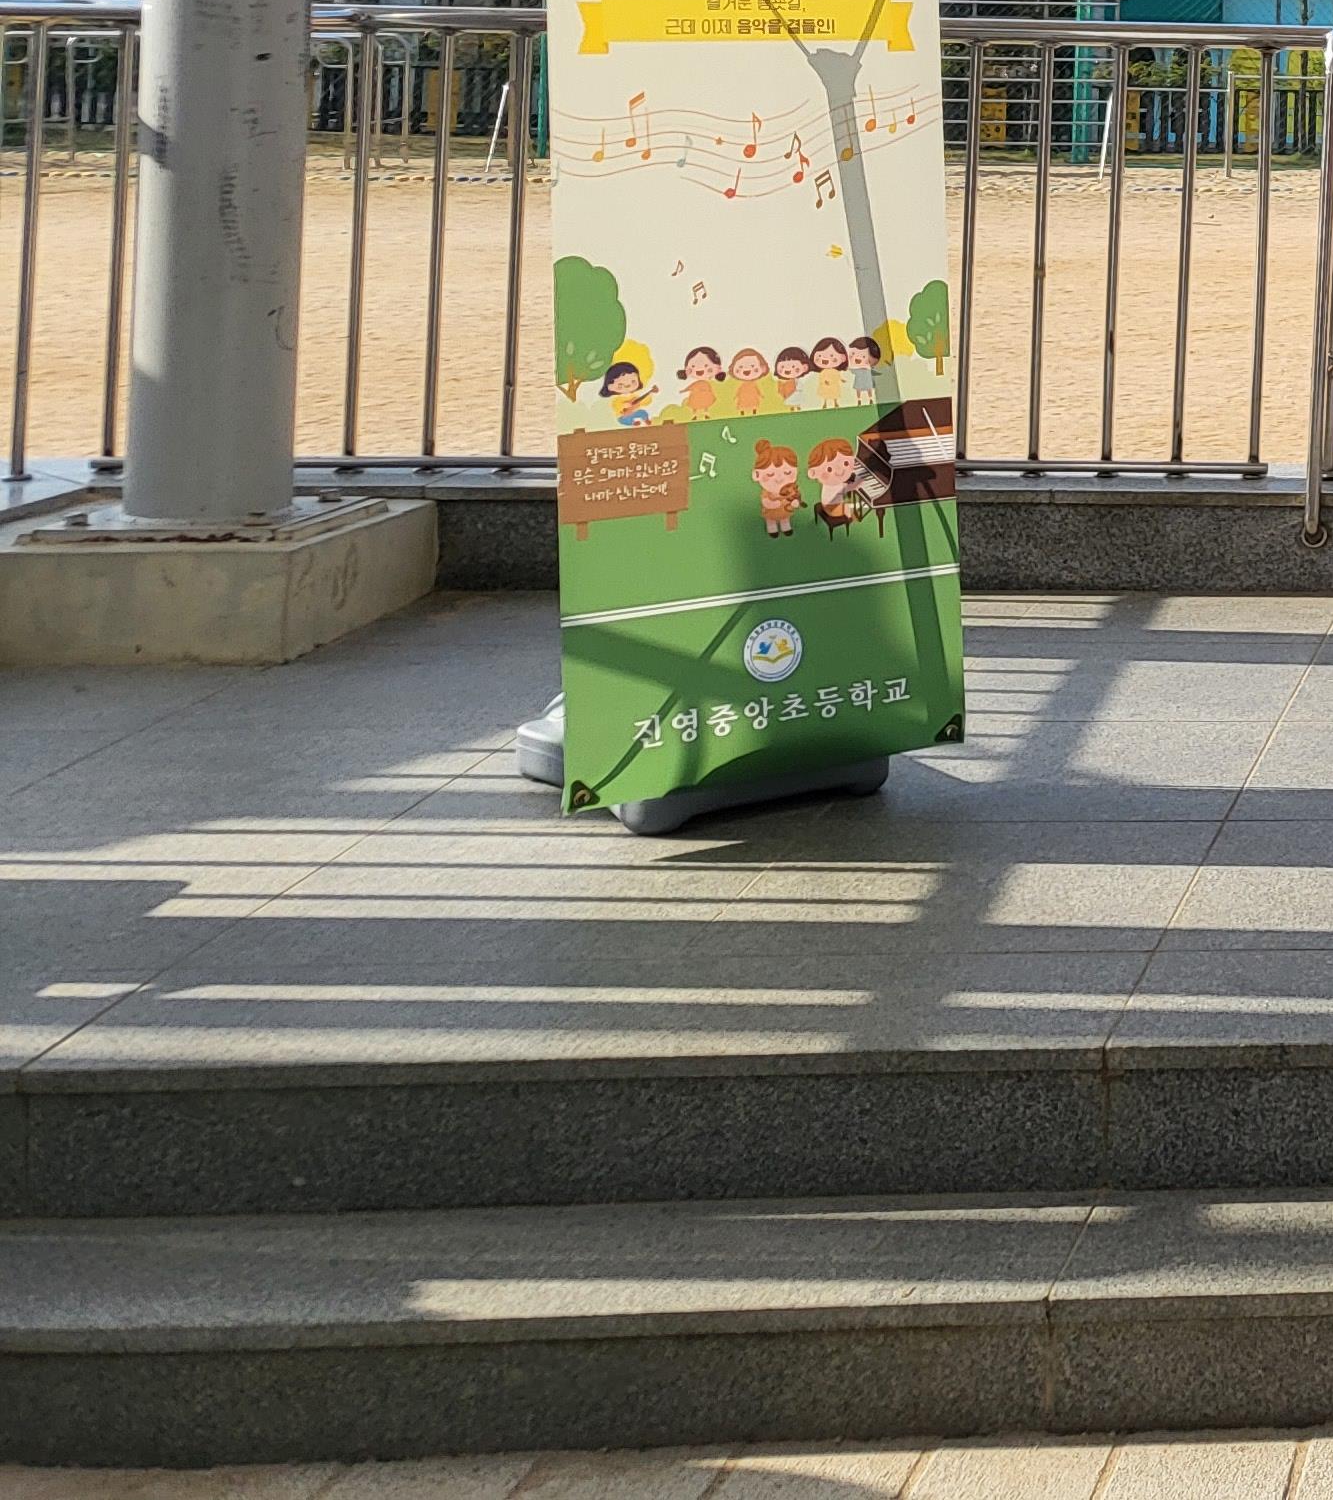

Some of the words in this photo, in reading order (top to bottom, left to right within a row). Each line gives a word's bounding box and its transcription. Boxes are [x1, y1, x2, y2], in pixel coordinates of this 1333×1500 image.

[665, 18, 696, 35] 근데
[701, 18, 732, 35] 이제
[736, 18, 782, 35] 음악을
[787, 18, 836, 35] 곁들인!
[632, 677, 912, 750] 진영중앙초등학교
